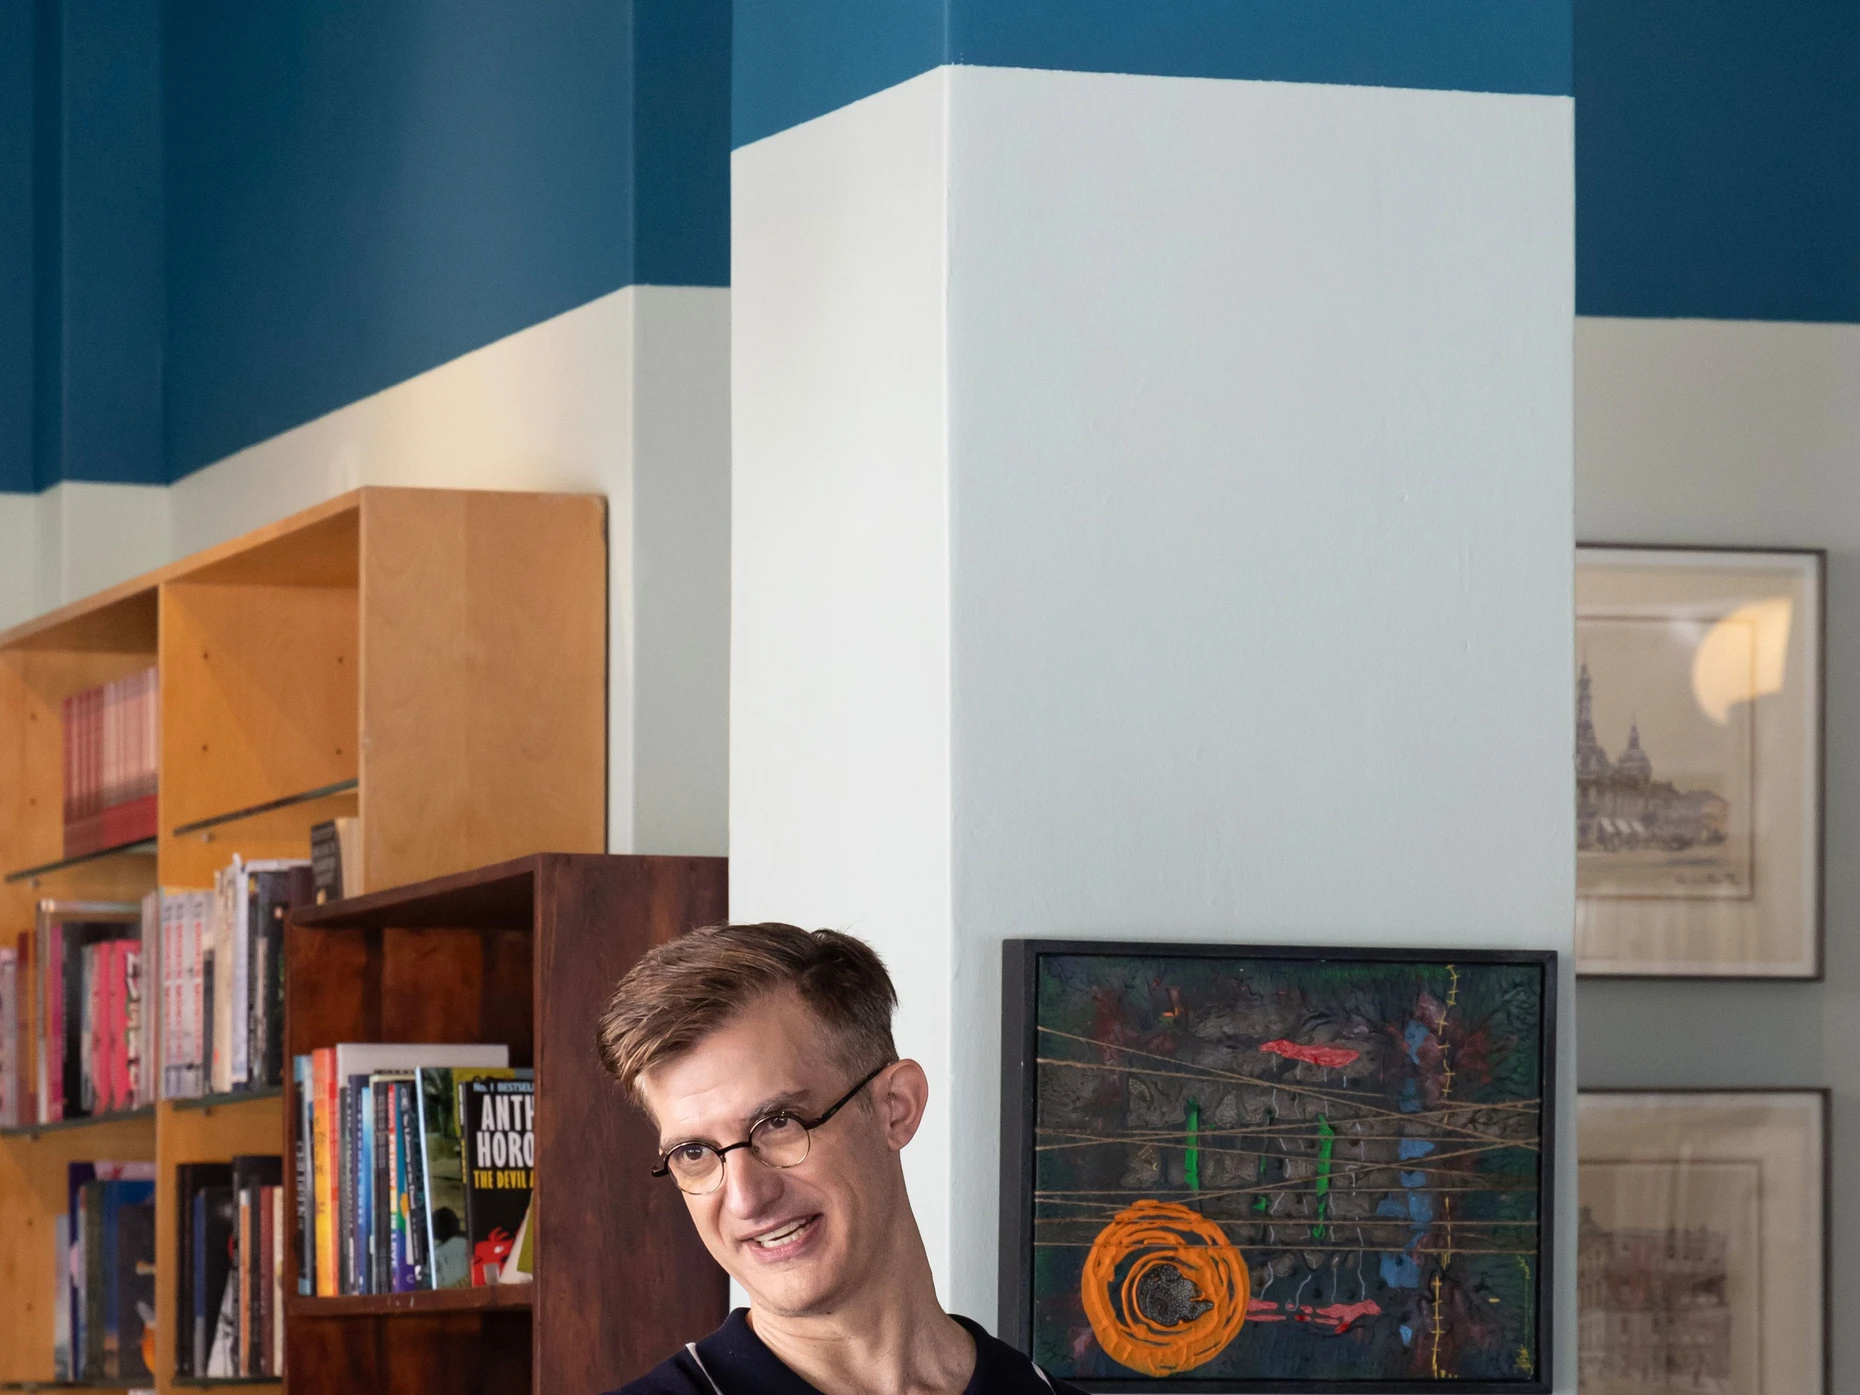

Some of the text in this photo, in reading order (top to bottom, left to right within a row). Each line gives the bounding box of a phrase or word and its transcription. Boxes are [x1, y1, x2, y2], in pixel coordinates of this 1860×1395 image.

[481, 1094, 535, 1131] ANTH
[476, 1131, 535, 1168] HORO
[473, 1170, 493, 1189] THE
[496, 1170, 527, 1189] DEVIL
